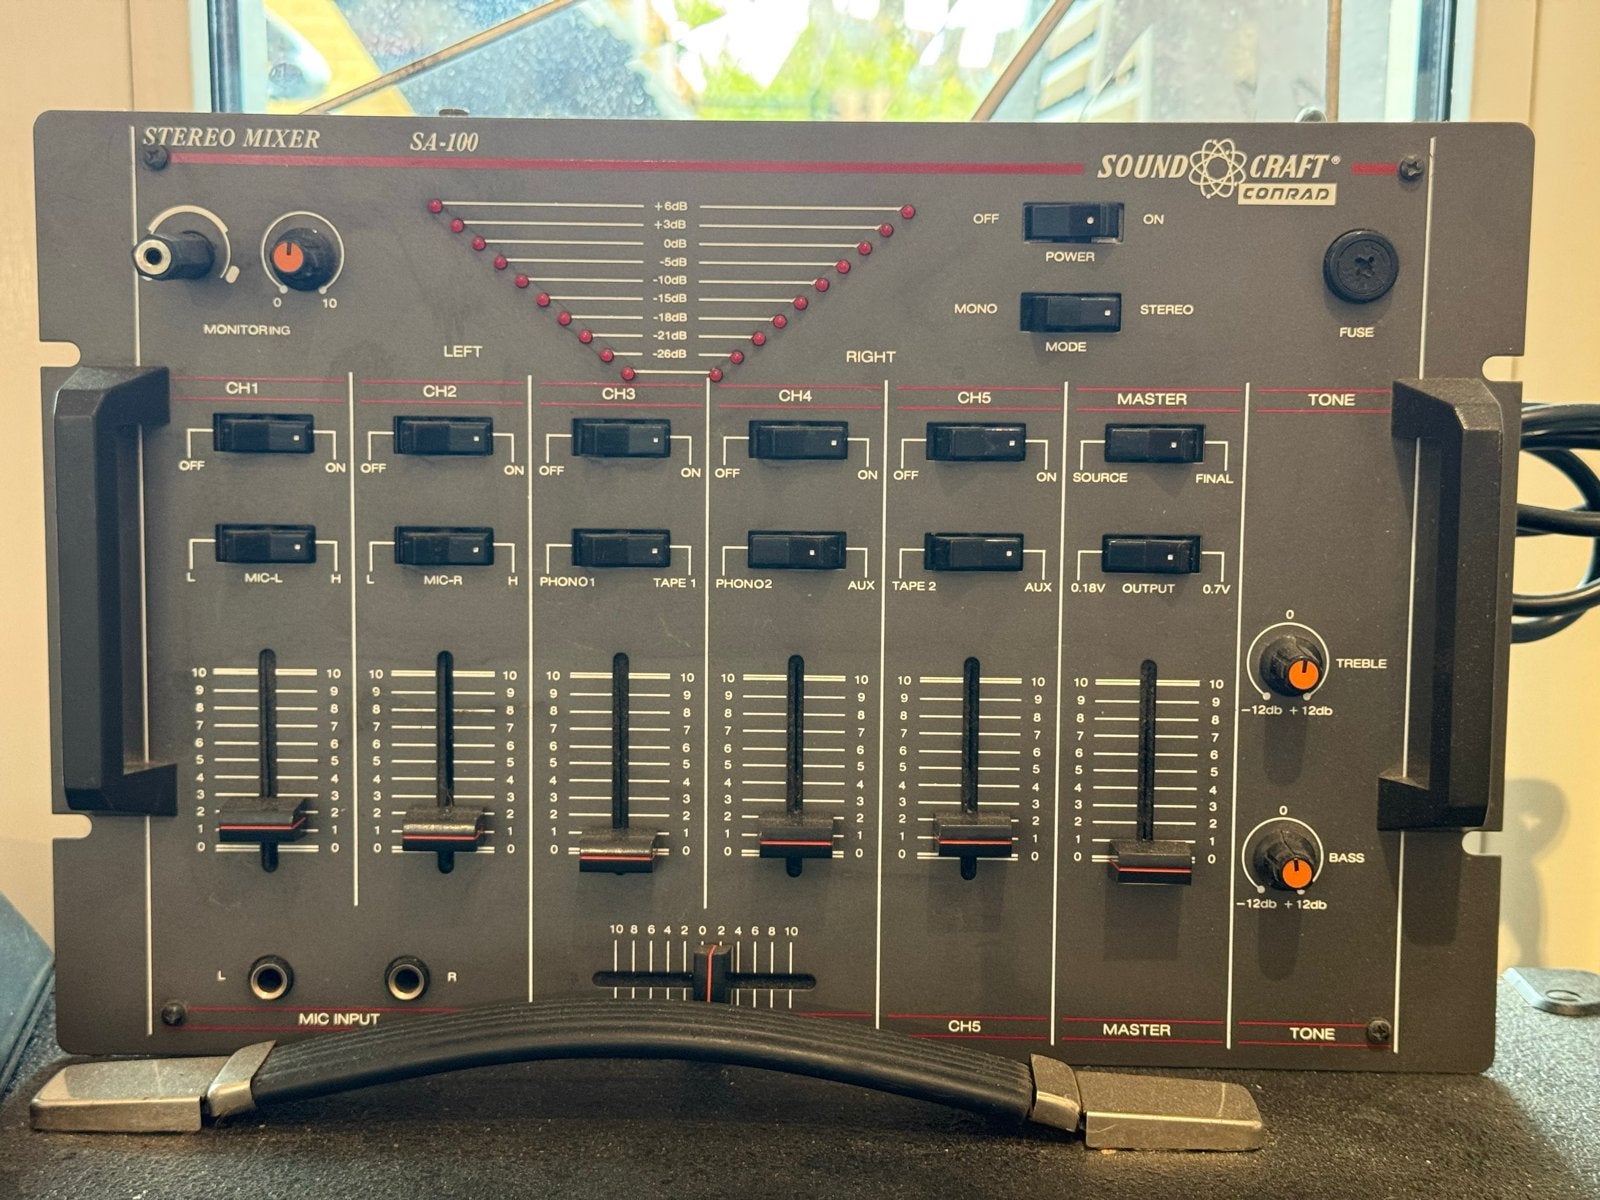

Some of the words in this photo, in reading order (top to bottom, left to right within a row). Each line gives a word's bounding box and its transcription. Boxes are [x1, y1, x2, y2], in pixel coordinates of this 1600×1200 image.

[142, 126, 236, 147] STEREO
[242, 127, 321, 149] MIXER
[409, 131, 479, 152] SA-100
[1096, 153, 1189, 179] SOUND
[972, 213, 1000, 225] OFF
[1142, 213, 1165, 225] ON
[663, 238, 687, 249] 0dB
[659, 256, 688, 267] -5dB
[1045, 251, 1095, 262] POWER
[652, 275, 688, 285] -10dB
[272, 297, 282, 308] 0
[322, 297, 338, 309] 10
[652, 293, 688, 303] -15dB
[954, 303, 998, 314] MONO
[1140, 303, 1194, 315] STEREO
[653, 312, 688, 323] -18dB
[203, 323, 291, 336] MONITORING
[1339, 326, 1374, 338] FUSE
[652, 330, 688, 341] -21dB
[443, 344, 483, 358] LEFT
[1045, 341, 1087, 353] MODE
[652, 348, 687, 359] -26dB
[846, 350, 897, 363] RIGHT
[225, 381, 258, 395] CH1
[422, 384, 457, 398] CH2
[601, 387, 636, 401] CH3
[778, 389, 813, 402] CH4
[957, 391, 992, 404] CH5
[1117, 392, 1188, 406] MASTER
[1307, 393, 1356, 407] TONE
[178, 460, 205, 471] OFF
[325, 462, 346, 473] ON
[360, 462, 387, 474] OFF
[503, 464, 525, 476] ON
[538, 465, 565, 476] OFF
[680, 467, 702, 478] ON
[714, 467, 741, 479] OFF
[857, 469, 878, 480] ON
[893, 470, 920, 481] OFF
[1036, 471, 1057, 483] ON
[1072, 471, 1128, 483] SOURCE
[1195, 473, 1234, 484] FINAL
[186, 571, 196, 583] L
[244, 572, 283, 584] MIC-L
[330, 573, 342, 584] H
[366, 574, 375, 585] L
[423, 574, 463, 586] MIC-R
[507, 575, 519, 586] H
[653, 577, 685, 588] TAPE
[715, 578, 773, 590] PHONO2
[847, 580, 875, 591] AUX
[891, 580, 923, 591] TAPE
[928, 581, 937, 592] 2
[1024, 582, 1052, 593] AUX
[1070, 582, 1106, 593] 0.18V
[1121, 582, 1176, 594] OUTPUT
[1202, 583, 1231, 595] 0.7V
[1285, 609, 1295, 620] 0
[1335, 658, 1388, 669] TREBLE
[191, 667, 207, 678] 10
[326, 668, 342, 679] 10
[368, 668, 384, 680] 10
[502, 670, 518, 681] 10
[546, 670, 561, 681] 10
[680, 672, 695, 683] 10
[720, 673, 736, 683] 10
[854, 674, 869, 685] 10
[897, 675, 912, 686] 10
[1031, 676, 1046, 687] 10
[1073, 677, 1089, 688] 10
[1209, 679, 1225, 690] 10
[195, 702, 205, 713] 8
[329, 703, 339, 714] 8
[372, 704, 381, 715] 8
[505, 705, 515, 716] 8
[549, 705, 558, 716] 8
[682, 707, 691, 718] 8
[724, 708, 733, 719] 8
[857, 710, 866, 720] 8
[899, 710, 908, 721] 8
[1033, 712, 1042, 723] 8
[1076, 712, 1085, 724] 8
[1210, 714, 1220, 725] 8
[195, 754, 205, 765] 5
[330, 755, 340, 766] 5
[372, 755, 381, 767] 5
[506, 757, 515, 768] 5
[549, 757, 558, 768] 5
[682, 759, 691, 770] 5
[724, 759, 732, 770] 5
[857, 761, 865, 772] 5
[899, 761, 907, 772] 5
[1032, 764, 1041, 774] 5
[1074, 764, 1083, 775] 5
[1210, 766, 1219, 777] 5
[196, 806, 205, 817] 2
[330, 807, 339, 818] 2
[373, 807, 382, 818] 2
[506, 808, 515, 819] 2
[549, 809, 558, 820] 2
[682, 810, 691, 821] 2
[1278, 805, 1288, 816] 0
[723, 811, 732, 822] 2
[856, 812, 864, 823] 2
[898, 813, 907, 824] 2
[1032, 815, 1040, 826] 2
[1074, 816, 1082, 827] 2
[1209, 818, 1218, 829] 2
[196, 841, 206, 852] 0
[330, 842, 340, 853] 0
[373, 842, 382, 854] 0
[506, 843, 516, 854] 0
[549, 844, 559, 855] 0
[682, 845, 691, 856] 0
[723, 846, 732, 857] 0
[855, 848, 864, 858] 0
[897, 848, 907, 860] 0
[1030, 851, 1039, 862] 0
[1073, 851, 1082, 862] 0
[1328, 852, 1365, 864] BASS
[1207, 853, 1217, 865] 0
[609, 923, 624, 934] 10
[630, 924, 638, 935] 8
[647, 924, 656, 935] 6
[663, 925, 672, 935] 4
[680, 925, 689, 935] 2
[698, 925, 707, 936] 0
[717, 925, 726, 936] 2
[734, 926, 743, 936] 4
[751, 925, 760, 936] 6
[767, 926, 776, 937] 8
[784, 926, 799, 937] 10
[217, 970, 227, 981] L
[447, 971, 457, 982] R
[298, 1012, 330, 1026] MIC
[333, 1012, 381, 1026] INPUT
[948, 1019, 982, 1033] CH5
[1102, 1023, 1171, 1037] MASTER
[1289, 1027, 1336, 1041] TONE
